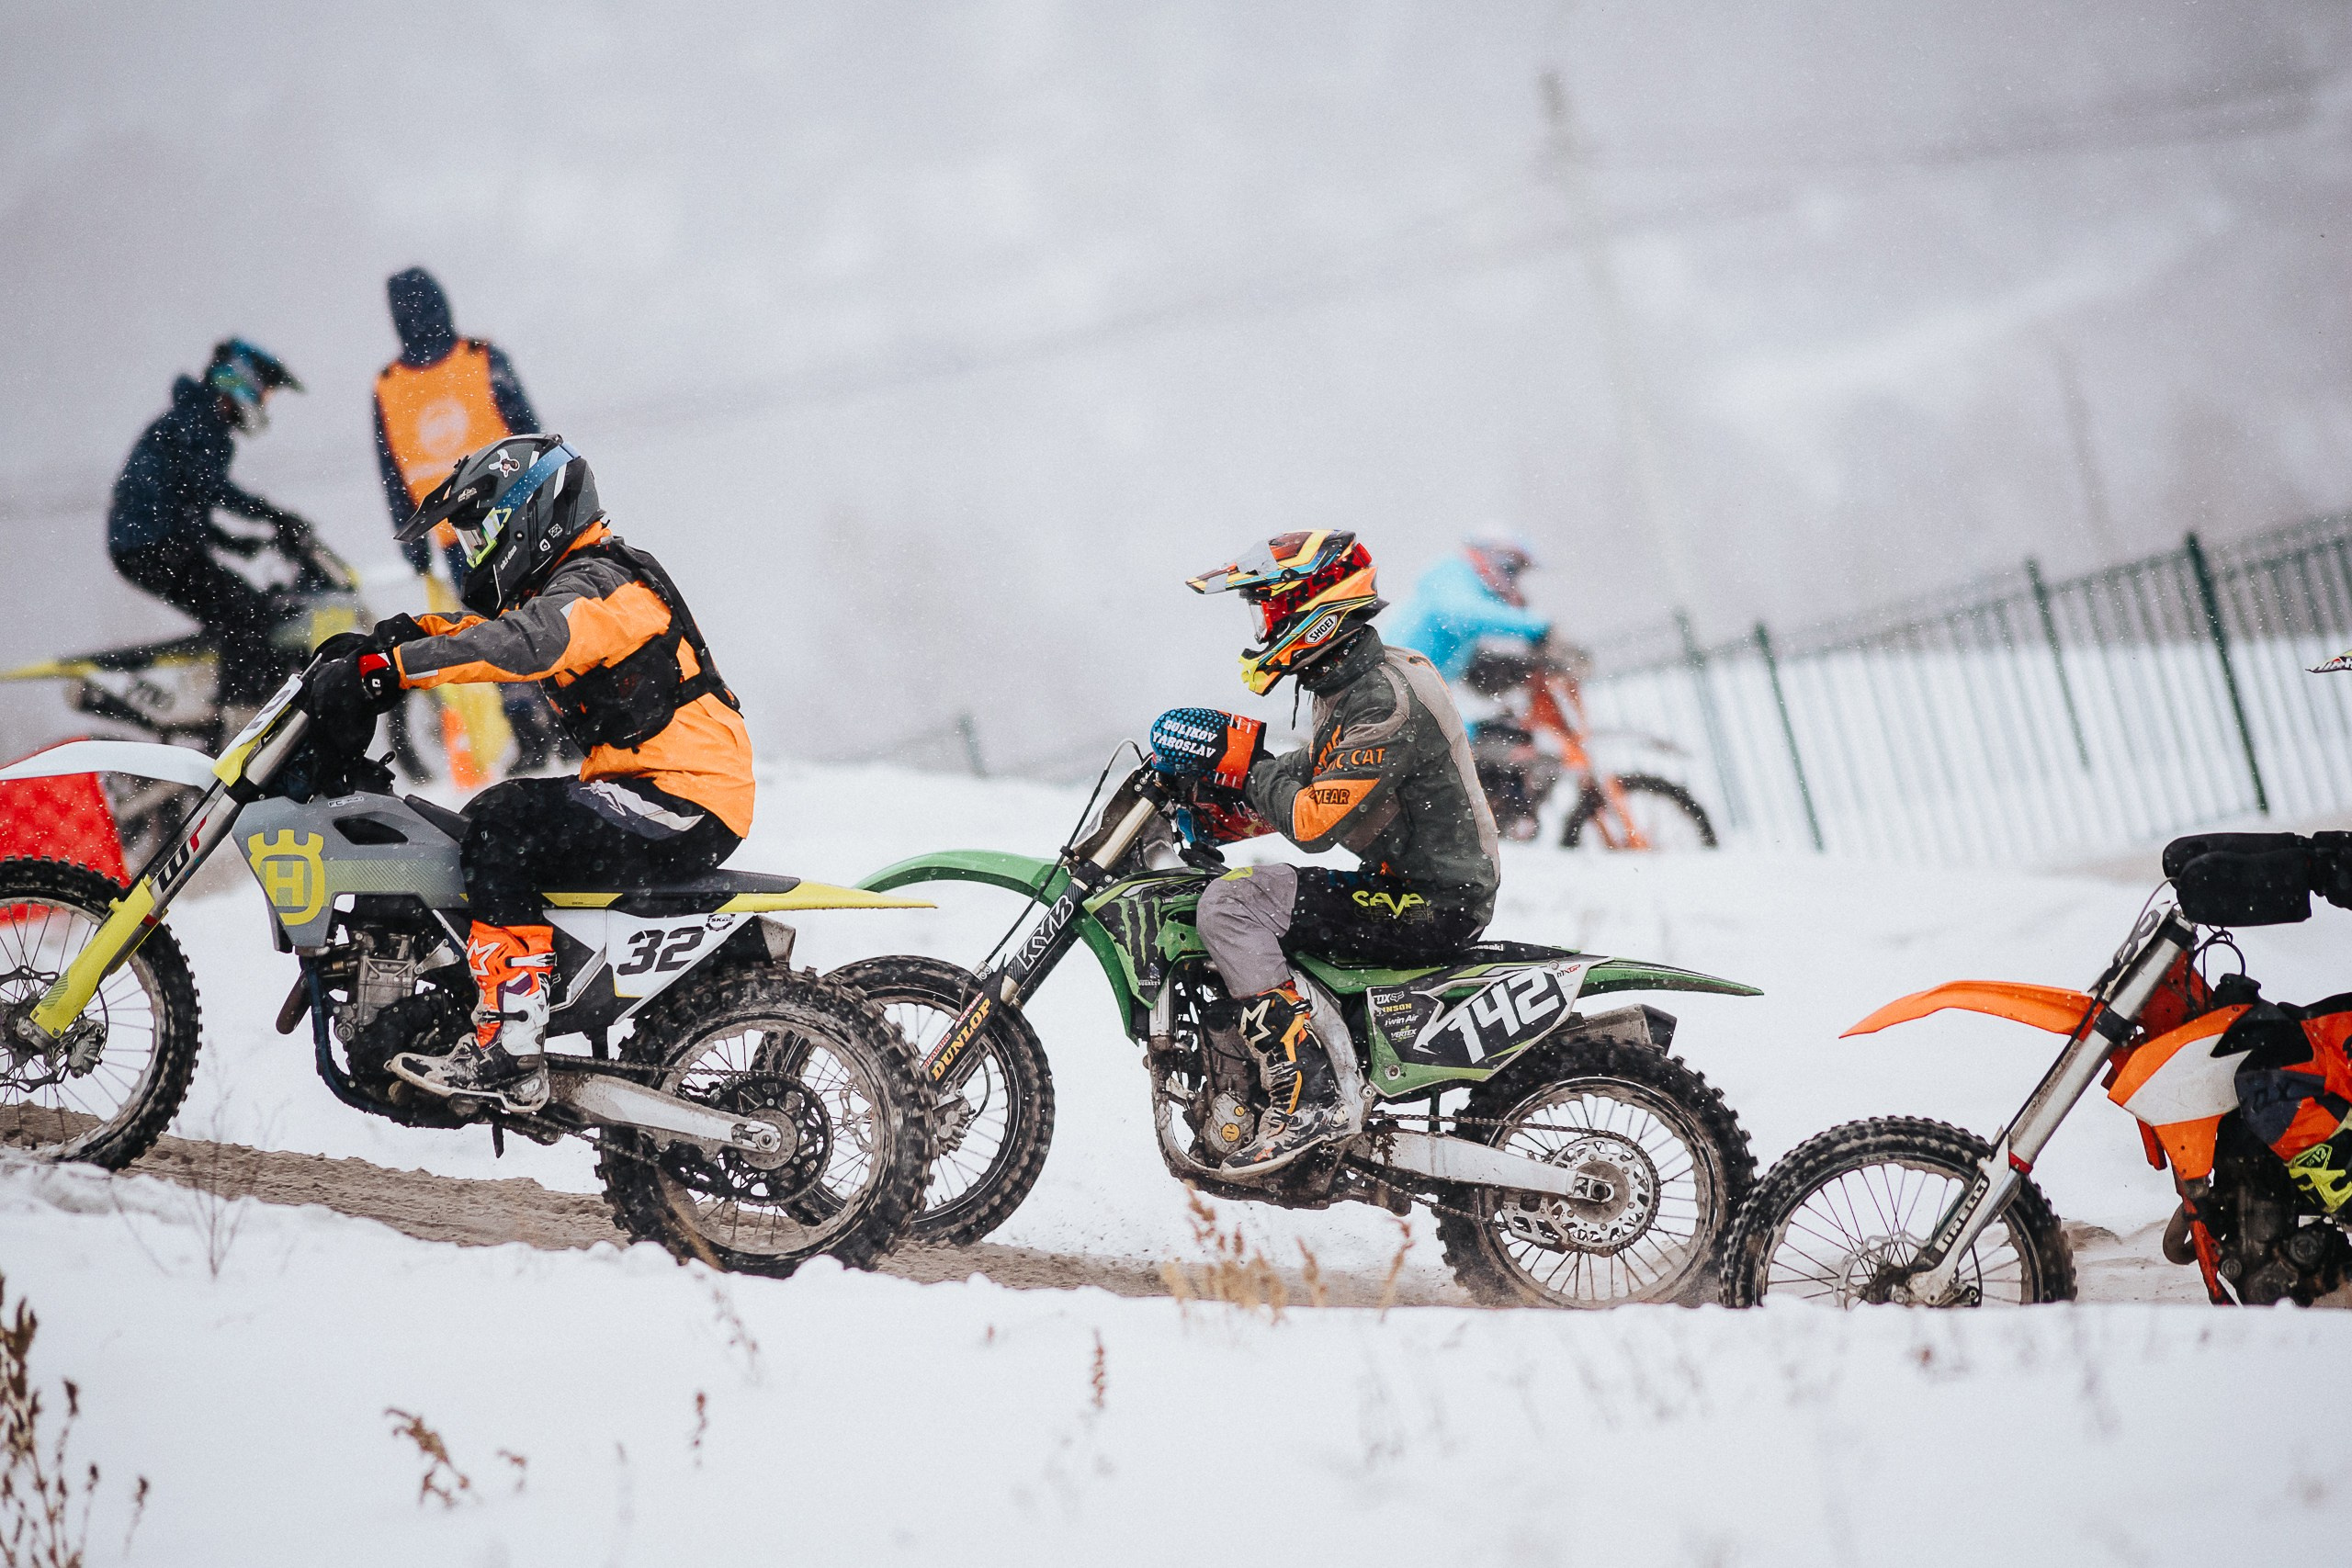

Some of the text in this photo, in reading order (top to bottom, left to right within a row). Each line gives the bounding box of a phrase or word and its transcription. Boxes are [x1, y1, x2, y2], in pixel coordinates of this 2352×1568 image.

[1308, 617, 1334, 642] SHOEI
[1163, 719, 1218, 743] GOLIKOV
[1151, 731, 1216, 759] YAROSLAV
[1351, 748, 1385, 765] CAT
[1016, 895, 1074, 971] KYB
[616, 926, 705, 976] 32
[1382, 1003, 1412, 1012] INSON
[1406, 1014, 1419, 1023] Air
[1447, 966, 1560, 1064] 142
[931, 998, 991, 1081] DUNLOP
[1391, 1029, 1418, 1038] VERTEX
[1934, 1178, 1988, 1254] PIRELLI
